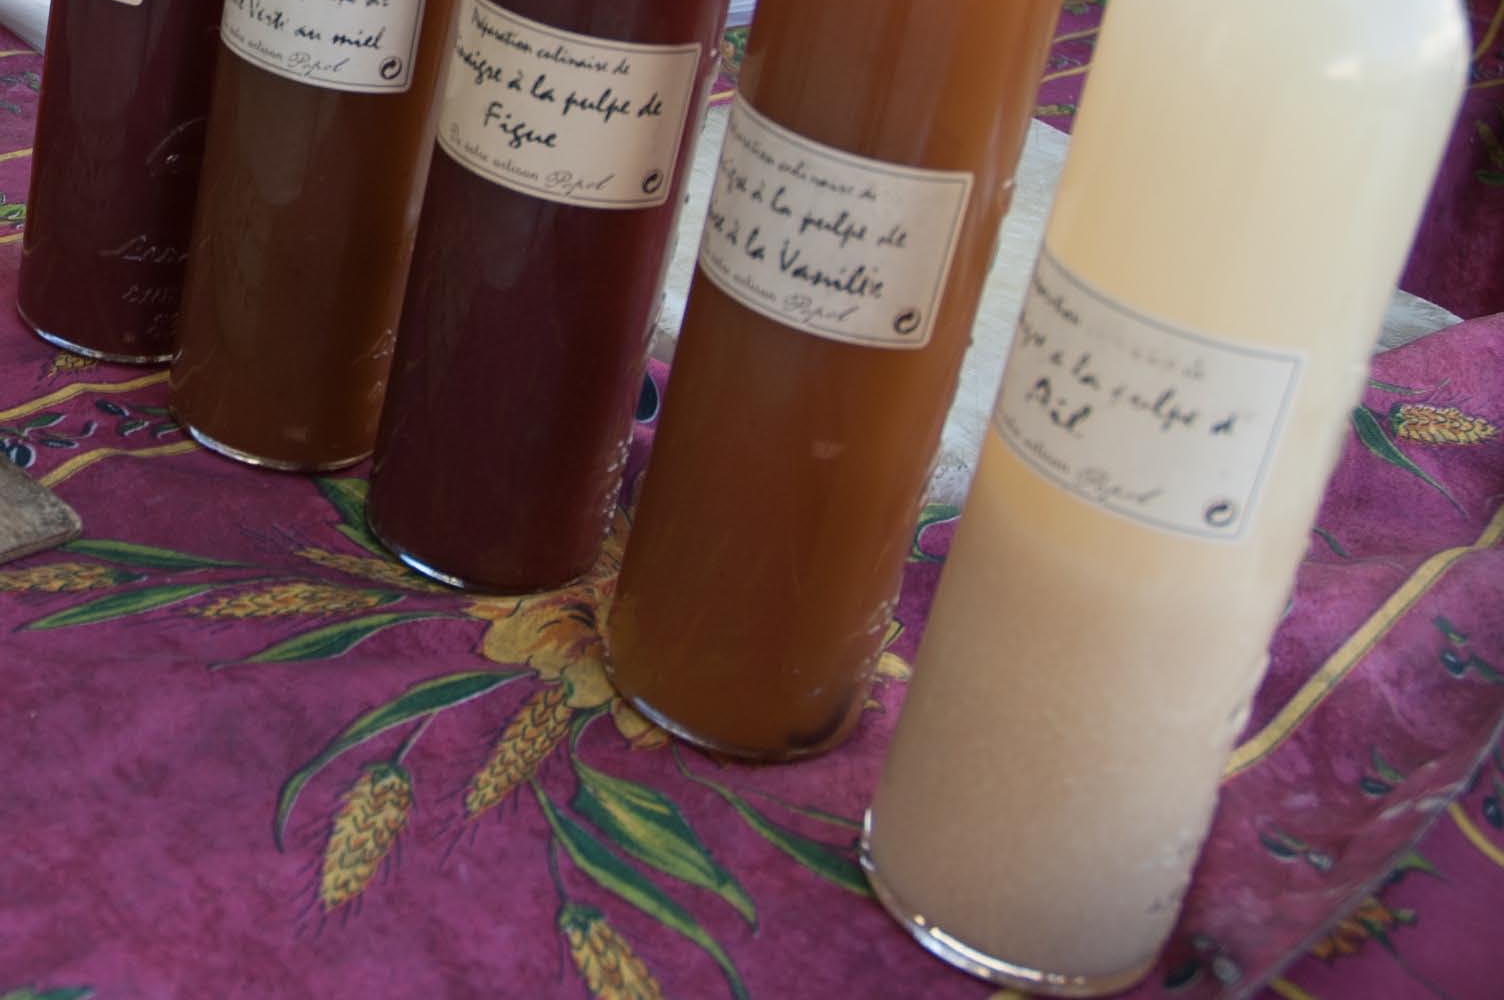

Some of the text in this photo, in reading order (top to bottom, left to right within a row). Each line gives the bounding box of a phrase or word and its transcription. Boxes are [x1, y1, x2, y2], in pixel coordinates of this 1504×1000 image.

[293, 19, 322, 43] au
[332, 26, 384, 51] miel
[287, 49, 352, 77] Popol
[537, 45, 609, 75] culinaire
[612, 58, 632, 76] de
[507, 70, 522, 92] à
[530, 74, 556, 102] la
[563, 88, 631, 122] pulpe
[638, 92, 663, 117] de
[482, 101, 558, 150] Figue
[545, 170, 617, 197] Popol
[769, 186, 793, 218] la
[799, 209, 868, 249] pulpe
[876, 225, 908, 249] de
[744, 228, 766, 263] la
[779, 239, 886, 299] Vanille
[1071, 352, 1101, 391] la
[1024, 376, 1093, 432] Ail
